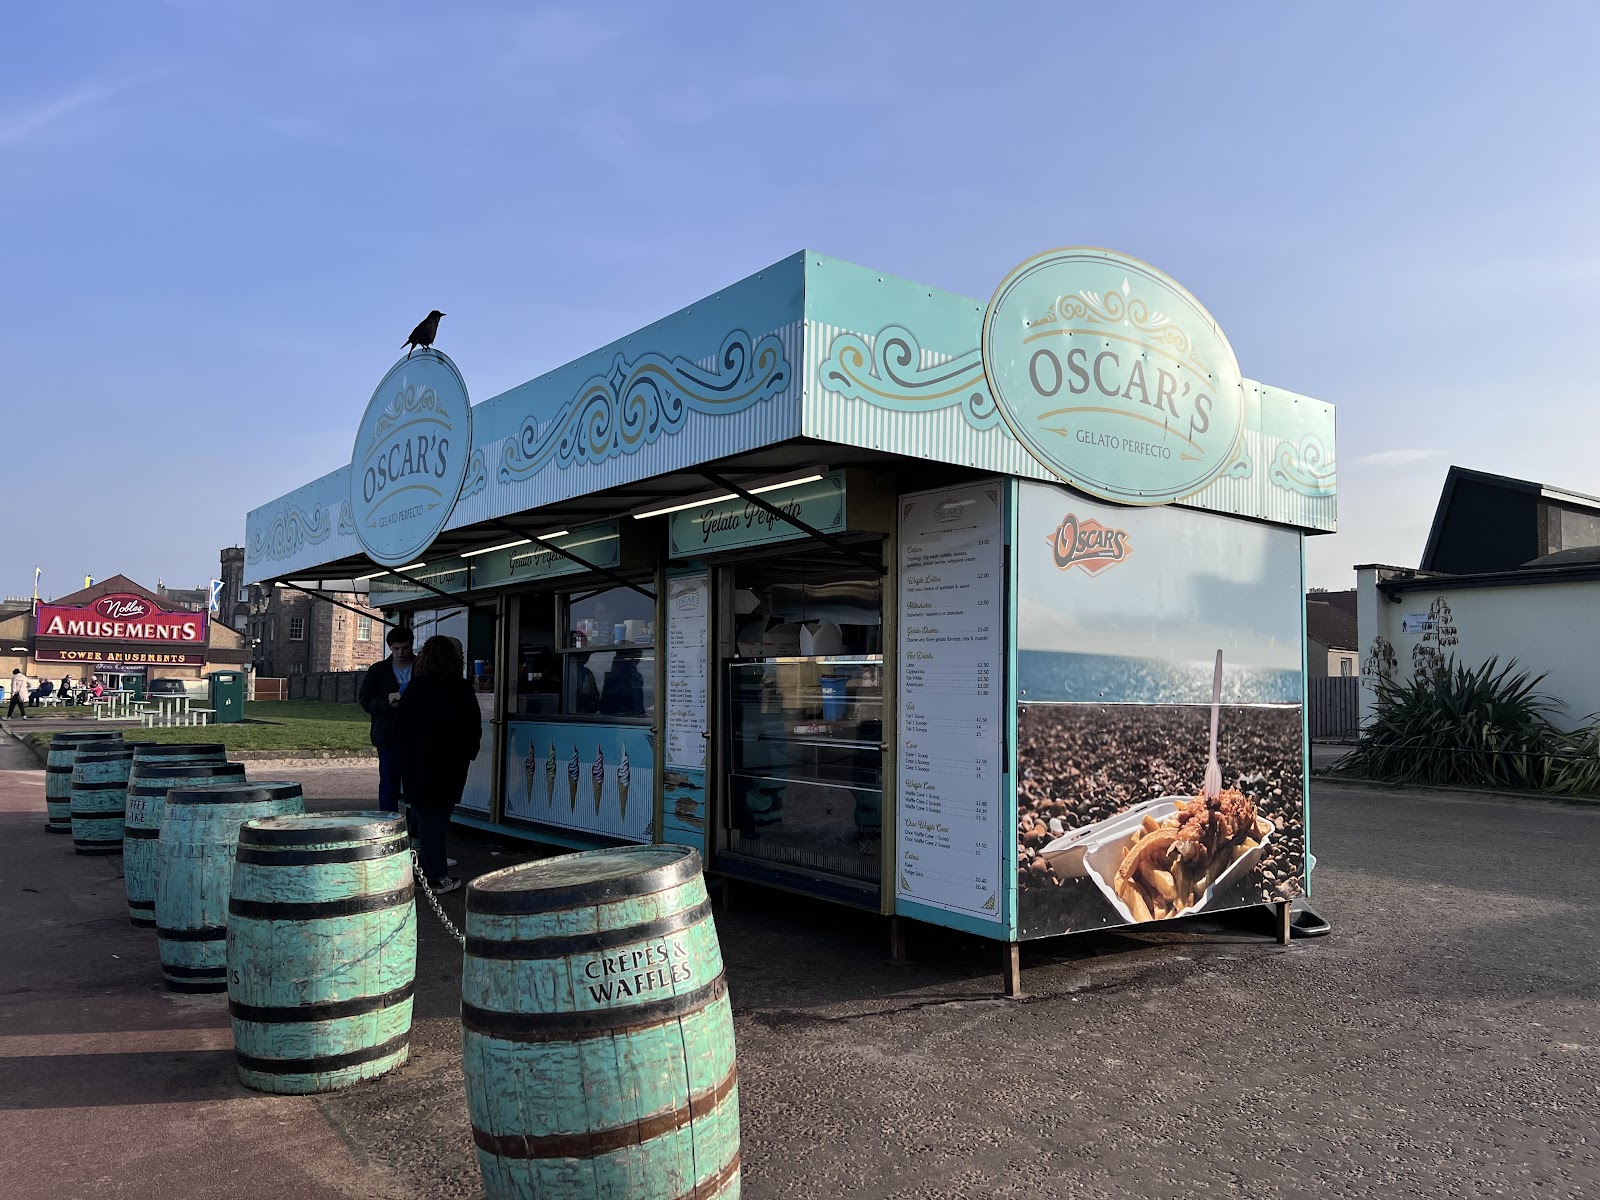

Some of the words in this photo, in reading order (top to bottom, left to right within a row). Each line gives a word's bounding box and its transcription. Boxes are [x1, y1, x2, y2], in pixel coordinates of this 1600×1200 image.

[1029, 348, 1212, 434] OSCAR'S
[1076, 429, 1119, 449] GELATO
[1122, 439, 1171, 460] PERFECTO
[363, 431, 449, 503] OSCAR'S
[379, 510, 398, 528] GELATO
[399, 505, 423, 523] PERFECTO
[700, 509, 740, 543] Gelato
[103, 599, 144, 618] Nobles
[46, 616, 196, 640] AMUSEMENTS
[60, 651, 102, 661] TOWER
[107, 652, 185, 663] AMUSEMENTS
[585, 942, 669, 979] CRÊPES
[674, 941, 688, 957] &
[588, 961, 692, 1004] WAFFLES
